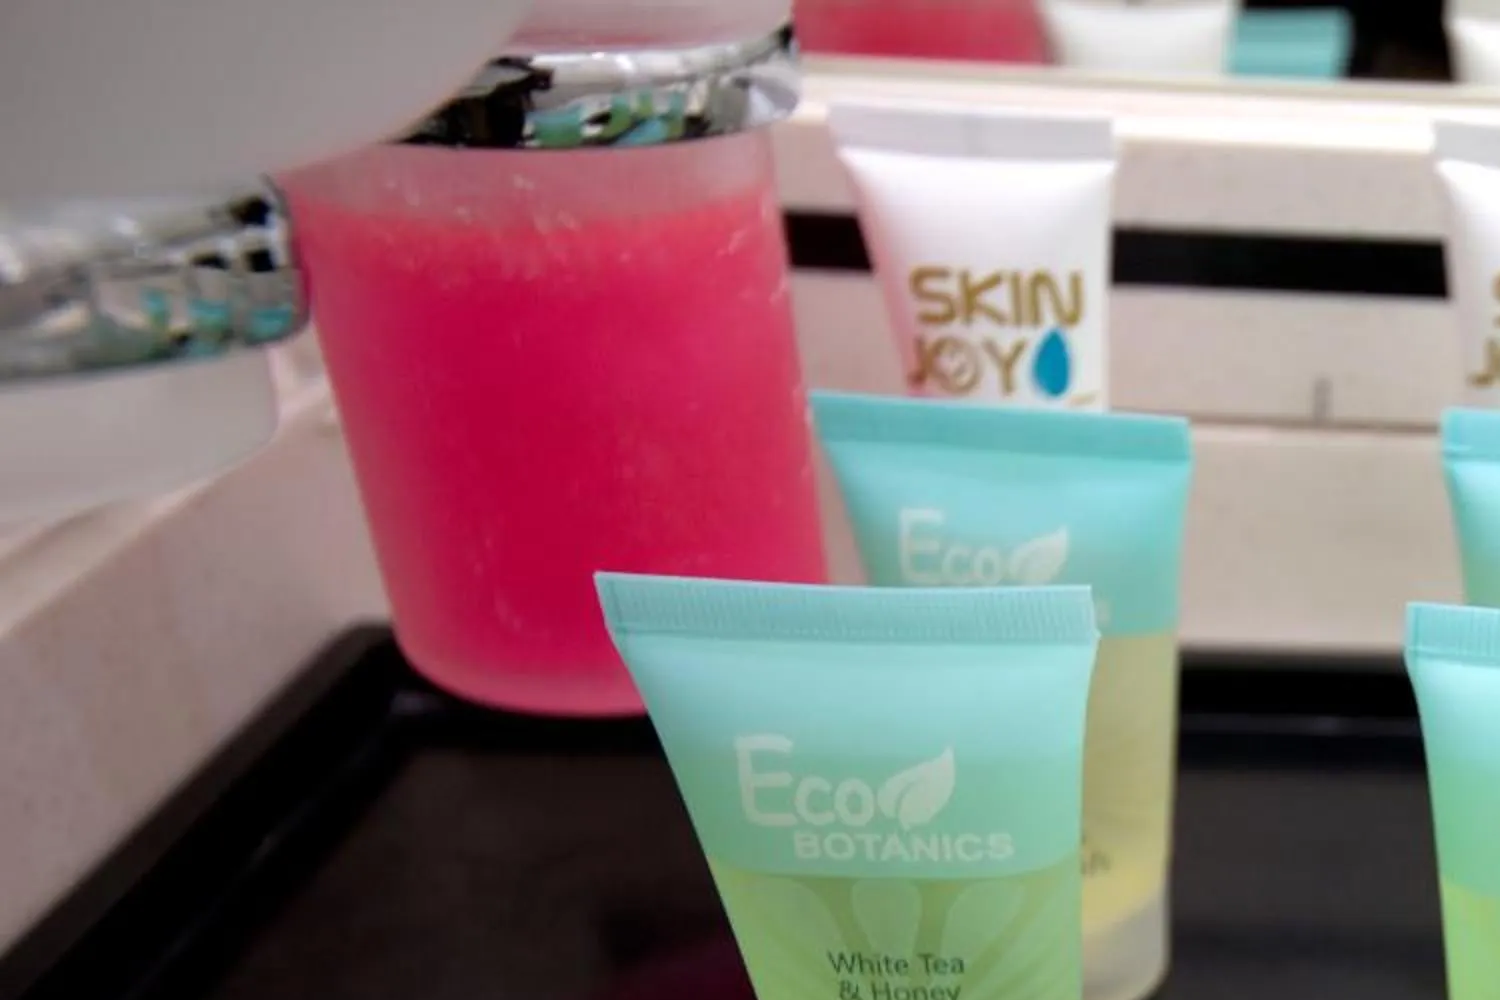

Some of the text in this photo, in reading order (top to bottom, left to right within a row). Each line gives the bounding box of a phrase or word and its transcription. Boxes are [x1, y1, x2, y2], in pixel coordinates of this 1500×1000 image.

[908, 267, 1085, 328] SKIN
[906, 336, 1029, 394] JOY
[733, 734, 876, 827] Eco
[793, 830, 1015, 862] BOTANICS
[828, 951, 964, 976] White Tea
